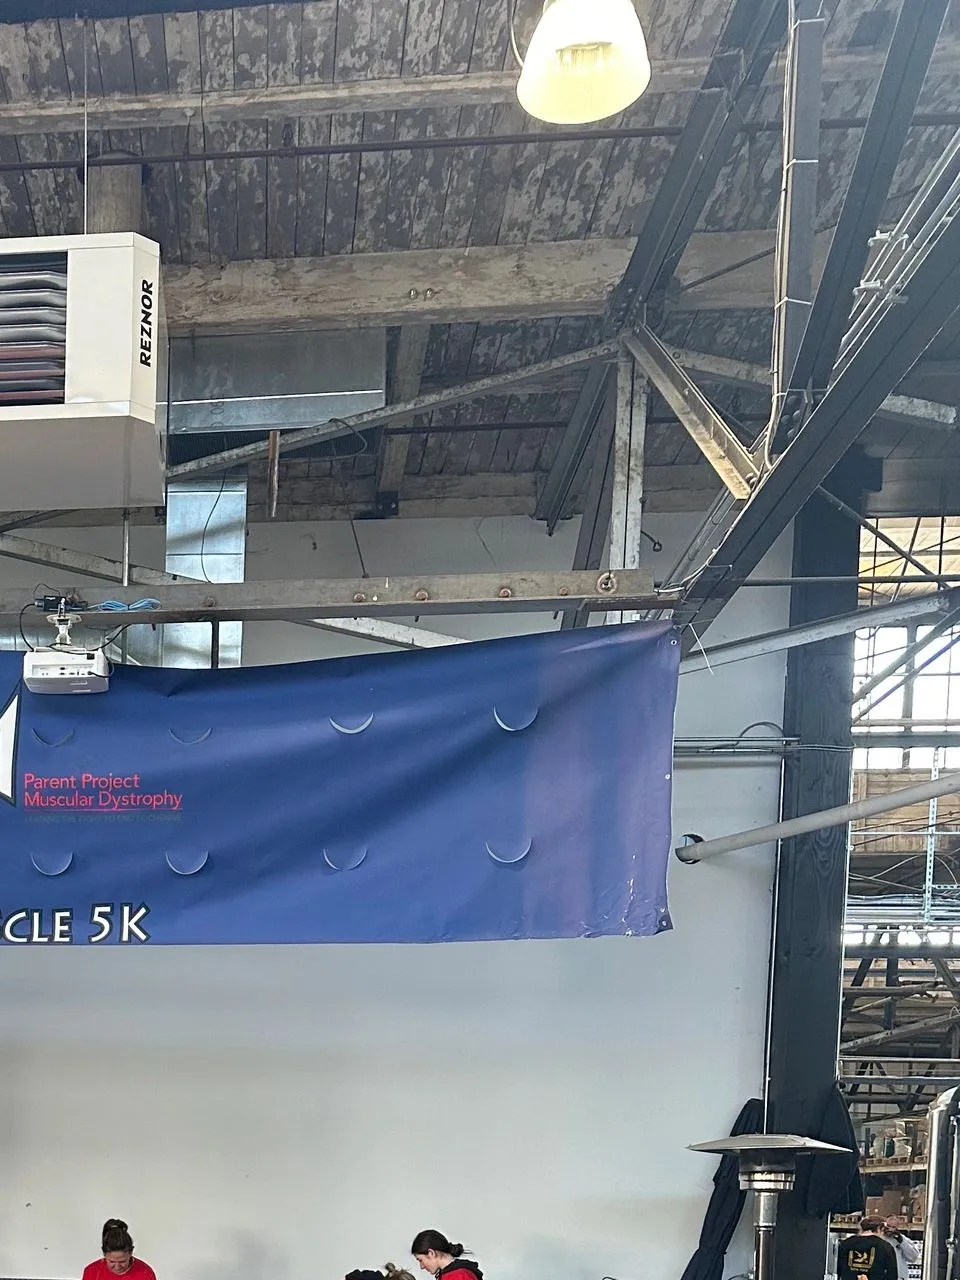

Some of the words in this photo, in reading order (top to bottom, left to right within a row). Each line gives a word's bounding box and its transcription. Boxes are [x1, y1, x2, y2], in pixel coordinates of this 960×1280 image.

[140, 279, 153, 367] REZNOR
[24, 773, 76, 789] Parent
[82, 772, 140, 792] Project
[24, 790, 94, 807] Muscular
[98, 789, 183, 810] Dystrophy
[90, 903, 148, 942] 5K
